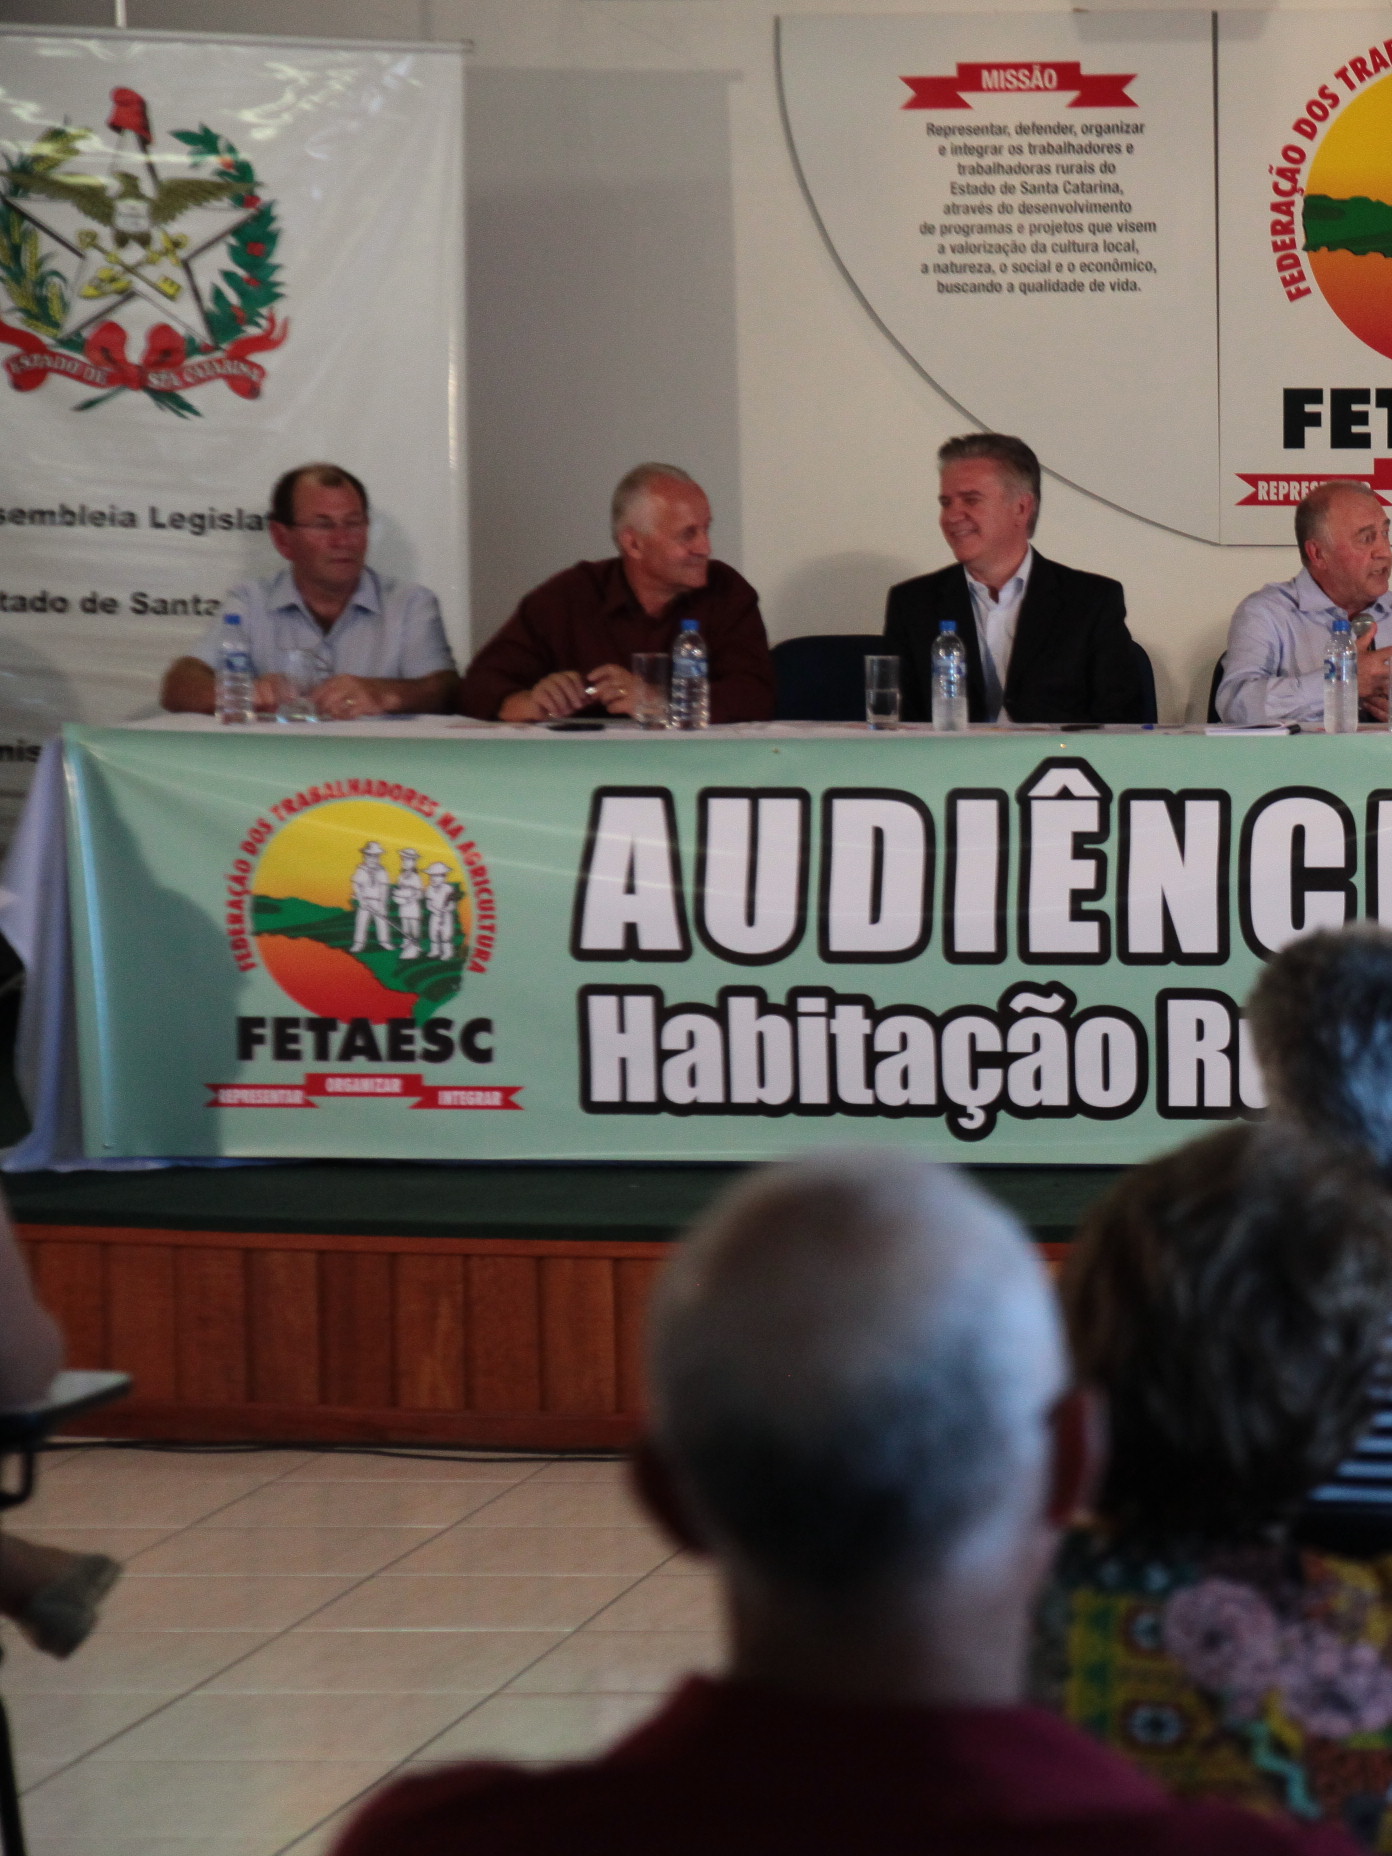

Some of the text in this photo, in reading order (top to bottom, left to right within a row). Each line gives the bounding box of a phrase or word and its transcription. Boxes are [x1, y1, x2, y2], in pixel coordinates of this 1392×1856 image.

[981, 64, 1058, 90] MISSÃO
[926, 121, 1145, 139] Representar, defender, organizar
[938, 142, 1134, 158] e integrar os trabalhadores e
[957, 160, 1116, 176] trabalhadoras rurais do
[950, 181, 1123, 196] Estado de Santa Catarina,
[1268, 143, 1311, 303] FEDERAÇÃO
[1293, 84, 1341, 141] DOS
[944, 200, 1132, 215] através do desenvolvimento
[920, 220, 1157, 238] de programas e projetos que visem
[938, 239, 1139, 256] a valorização da cultura local,
[921, 258, 1157, 274] a natureza, o social e o econômico,
[937, 278, 1141, 295] buscando a qualidade de vida.
[80, 591, 119, 615] de
[240, 818, 274, 857] DOS
[270, 778, 440, 819] TRABALHADORES
[437, 812, 466, 840] NA
[457, 841, 497, 974] AGRICULTURA
[237, 1015, 494, 1064] FETAESC
[578, 982, 1149, 1141] Habitação
